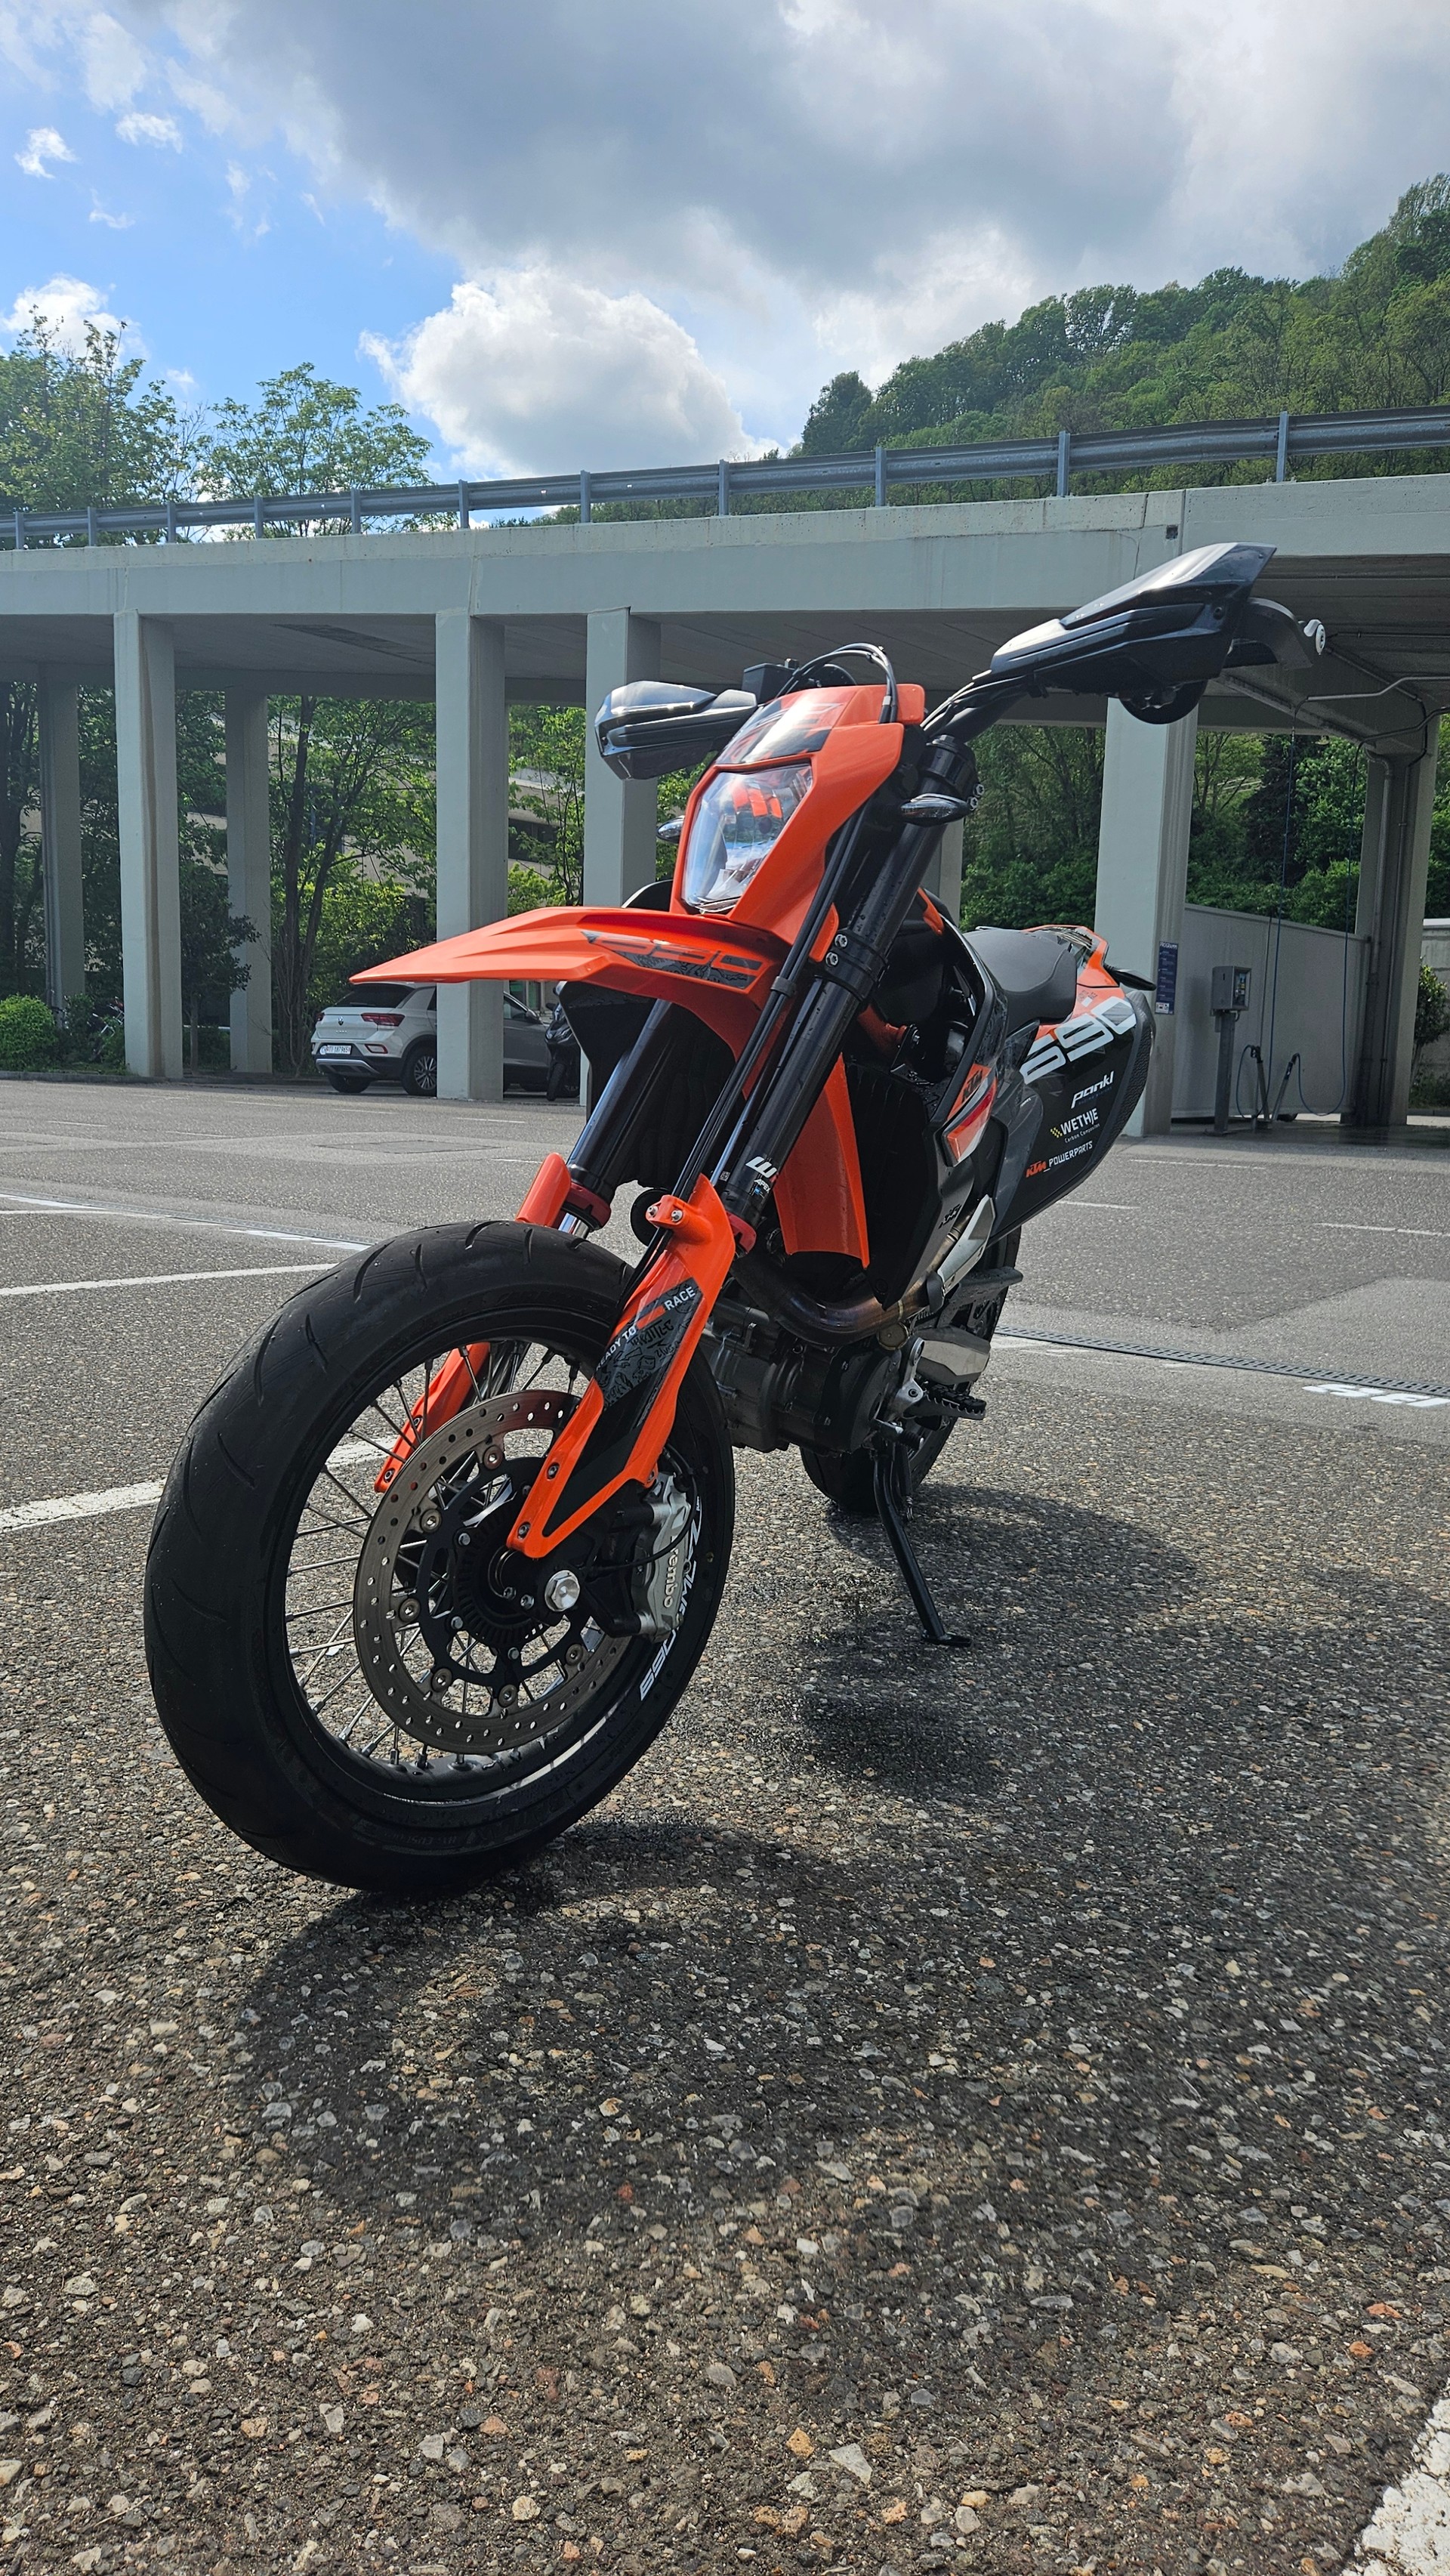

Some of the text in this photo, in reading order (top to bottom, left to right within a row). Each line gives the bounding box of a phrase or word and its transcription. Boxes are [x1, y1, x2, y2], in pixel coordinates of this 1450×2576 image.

[1020, 996, 1137, 1085] 690
[1071, 1071, 1114, 1109] pankl
[1060, 1108, 1098, 1135] WETHJE
[754, 1178, 771, 1194] APEX
[622, 1325, 637, 1340] TO
[665, 1286, 696, 1310] RACE
